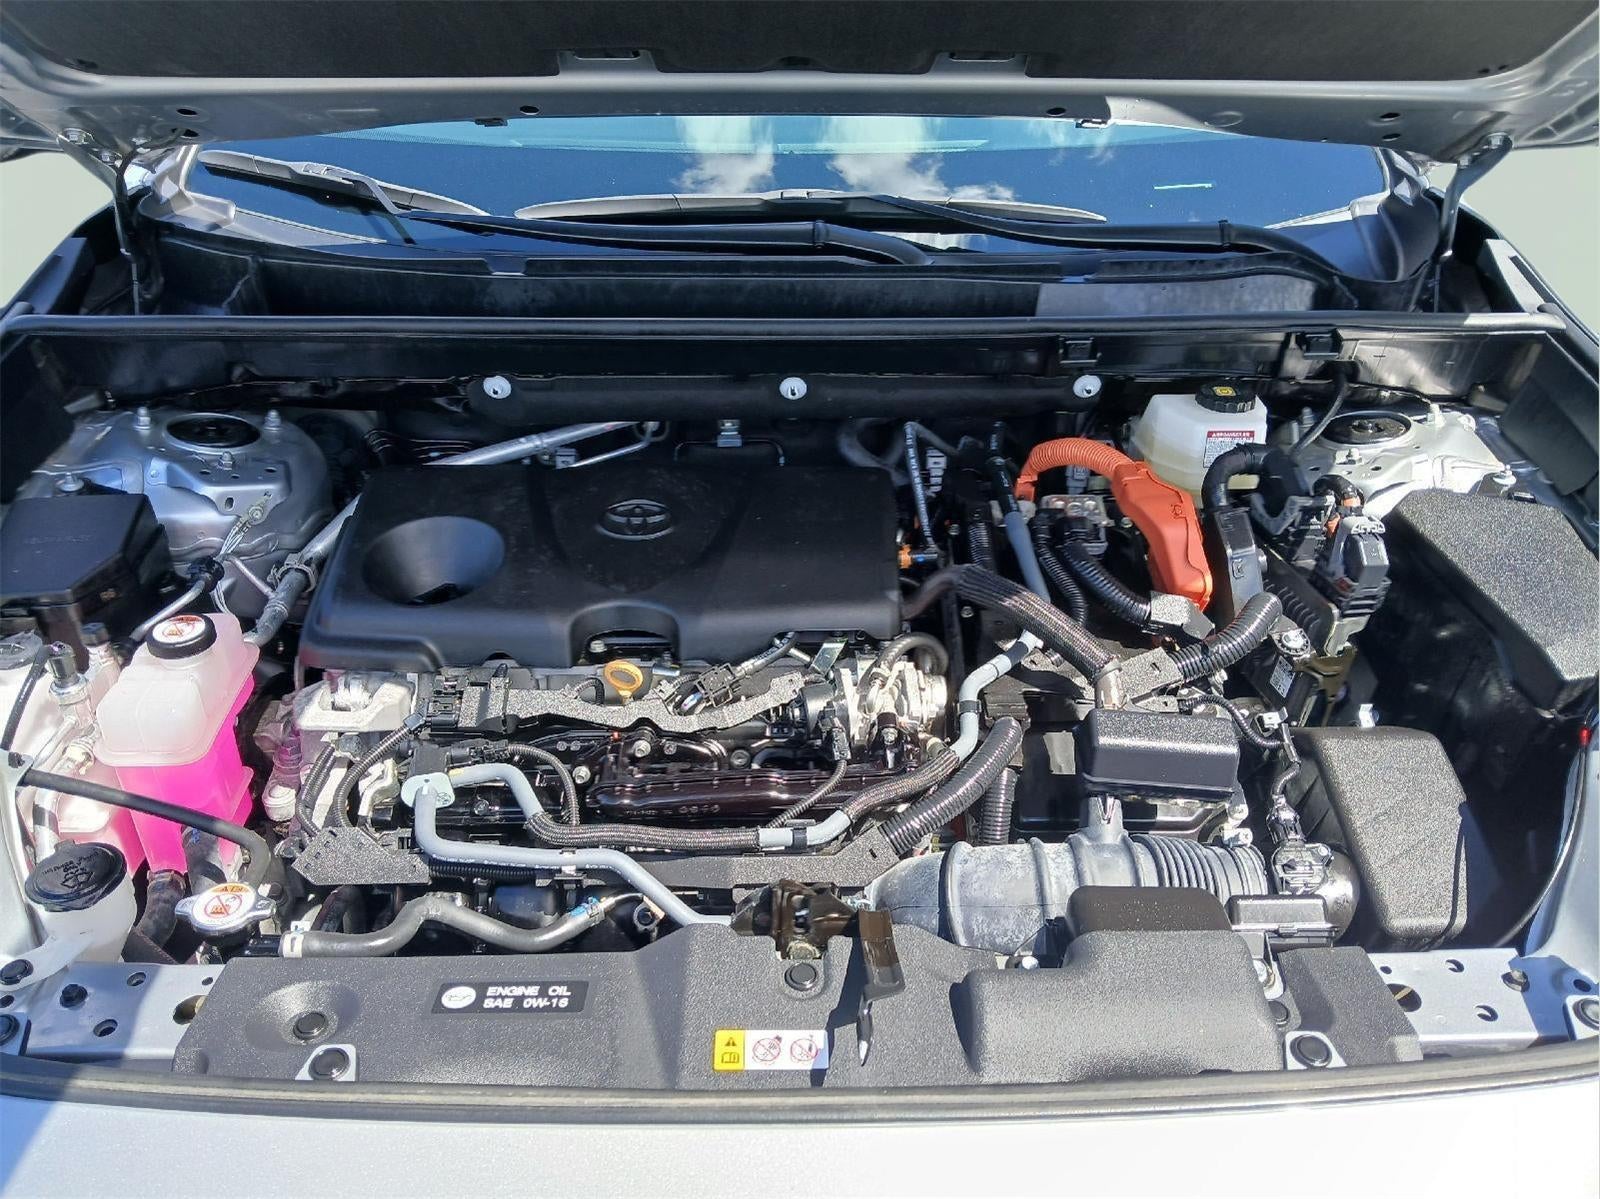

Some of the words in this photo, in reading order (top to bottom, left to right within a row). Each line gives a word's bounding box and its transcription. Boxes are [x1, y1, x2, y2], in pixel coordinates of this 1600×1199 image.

[486, 986, 540, 996] ENGINE
[548, 985, 571, 996] OIL
[483, 998, 514, 1008] SAE
